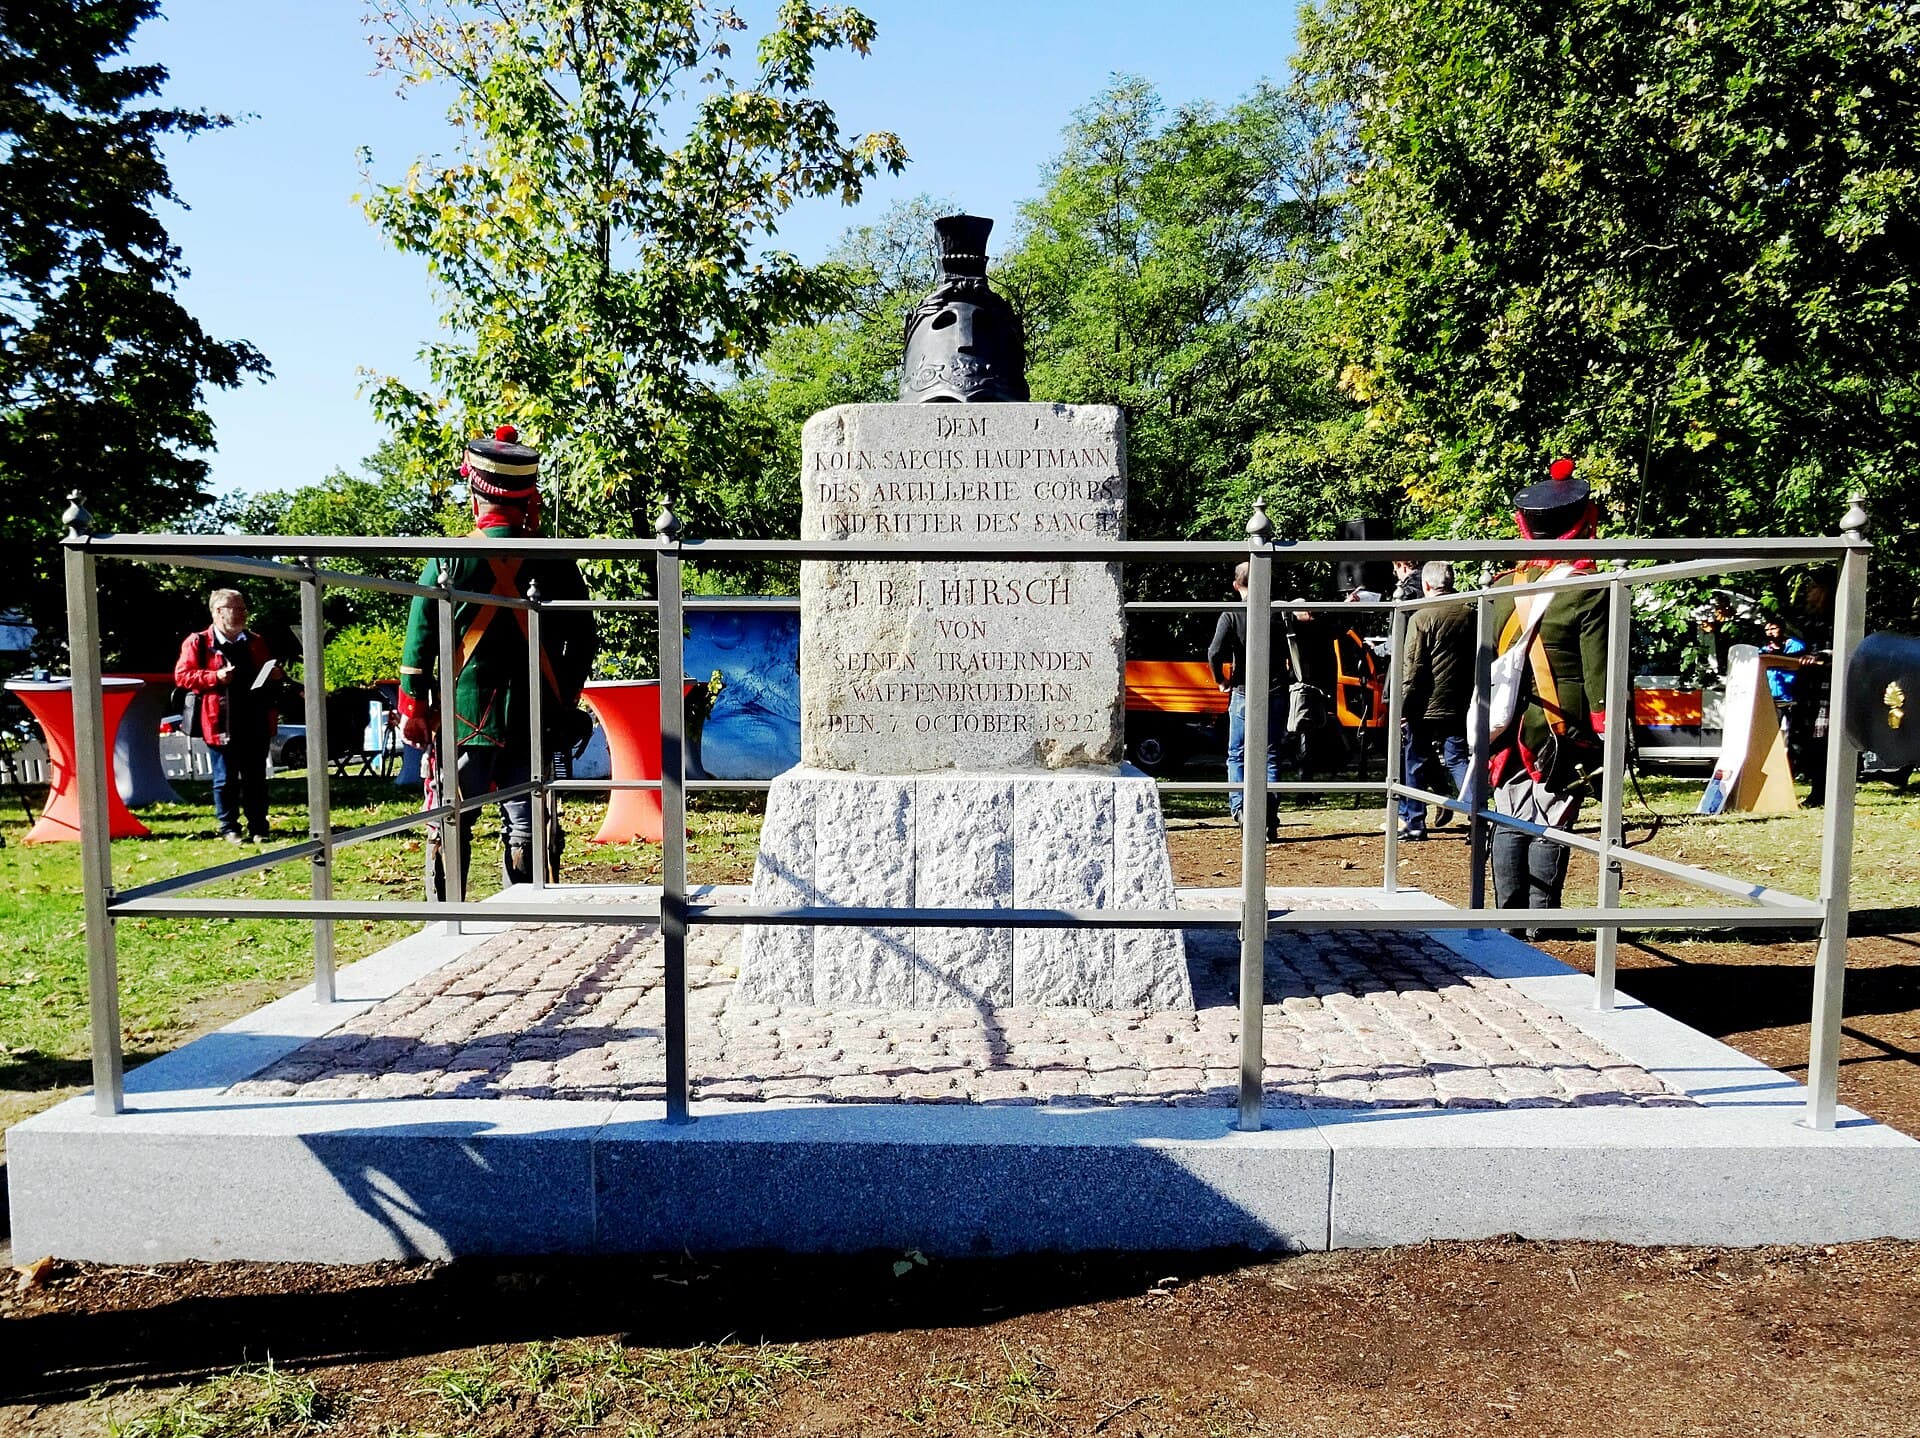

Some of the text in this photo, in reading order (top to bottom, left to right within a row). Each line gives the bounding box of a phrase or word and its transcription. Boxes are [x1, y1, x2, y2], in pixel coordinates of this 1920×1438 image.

[936, 417, 988, 438] DEM
[975, 448, 1109, 469] HAUPTMANN
[819, 480, 1113, 503] DES ARTILLERIE CORPS
[822, 512, 1114, 533] UND RITTER DES SANCT
[939, 578, 1071, 606] HIRSCH
[937, 620, 987, 640] VON
[834, 651, 1093, 671] SEINEN TRAUERNDEN
[915, 714, 1027, 733] OCTOBER
